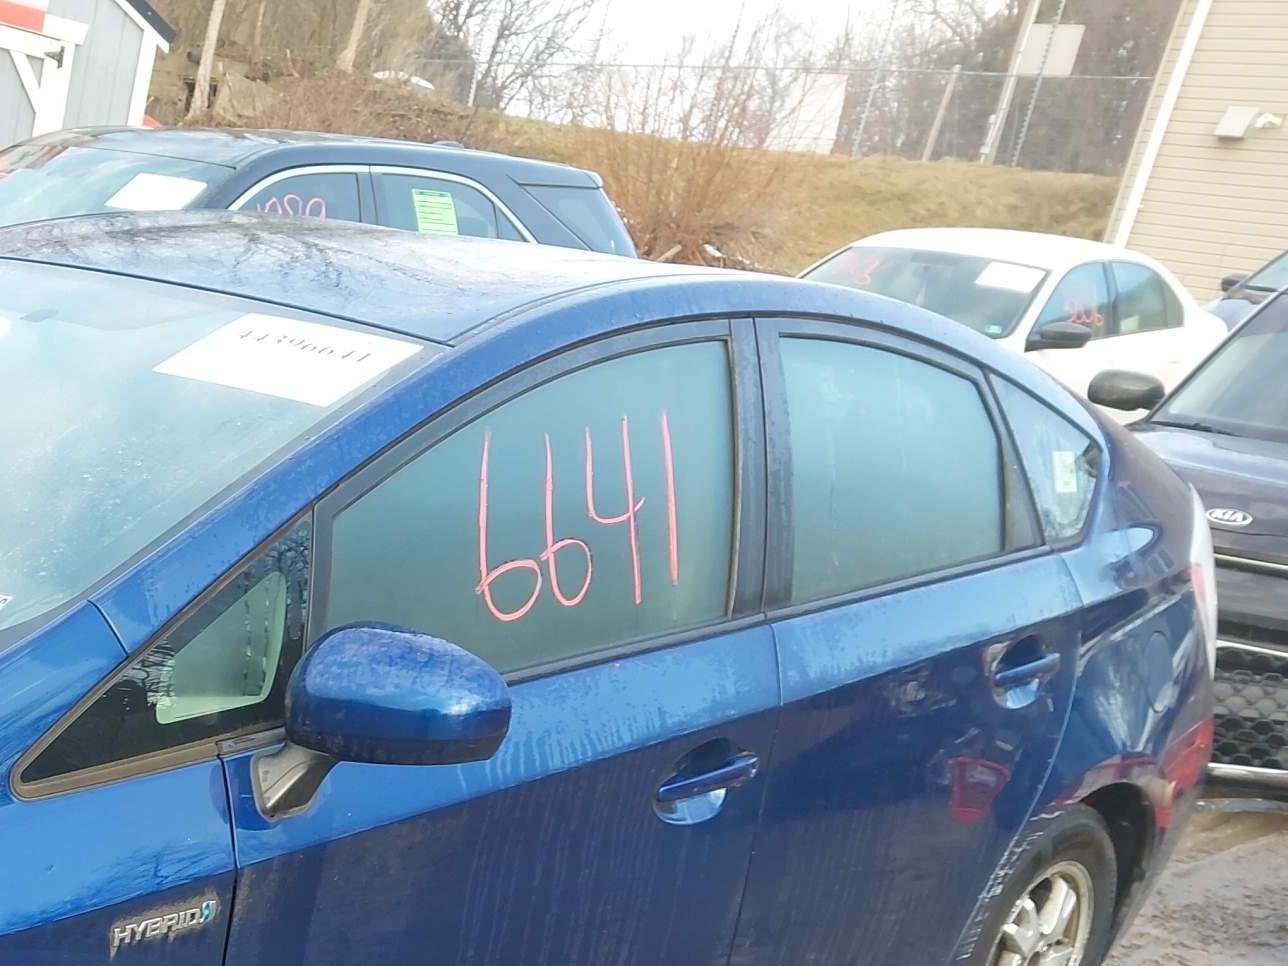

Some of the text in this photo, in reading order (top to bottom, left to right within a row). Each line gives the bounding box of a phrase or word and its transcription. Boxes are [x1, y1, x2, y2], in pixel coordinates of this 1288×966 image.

[474, 409, 679, 622] 6641
[1208, 509, 1250, 524] KIA
[113, 908, 201, 947] HYBRID
